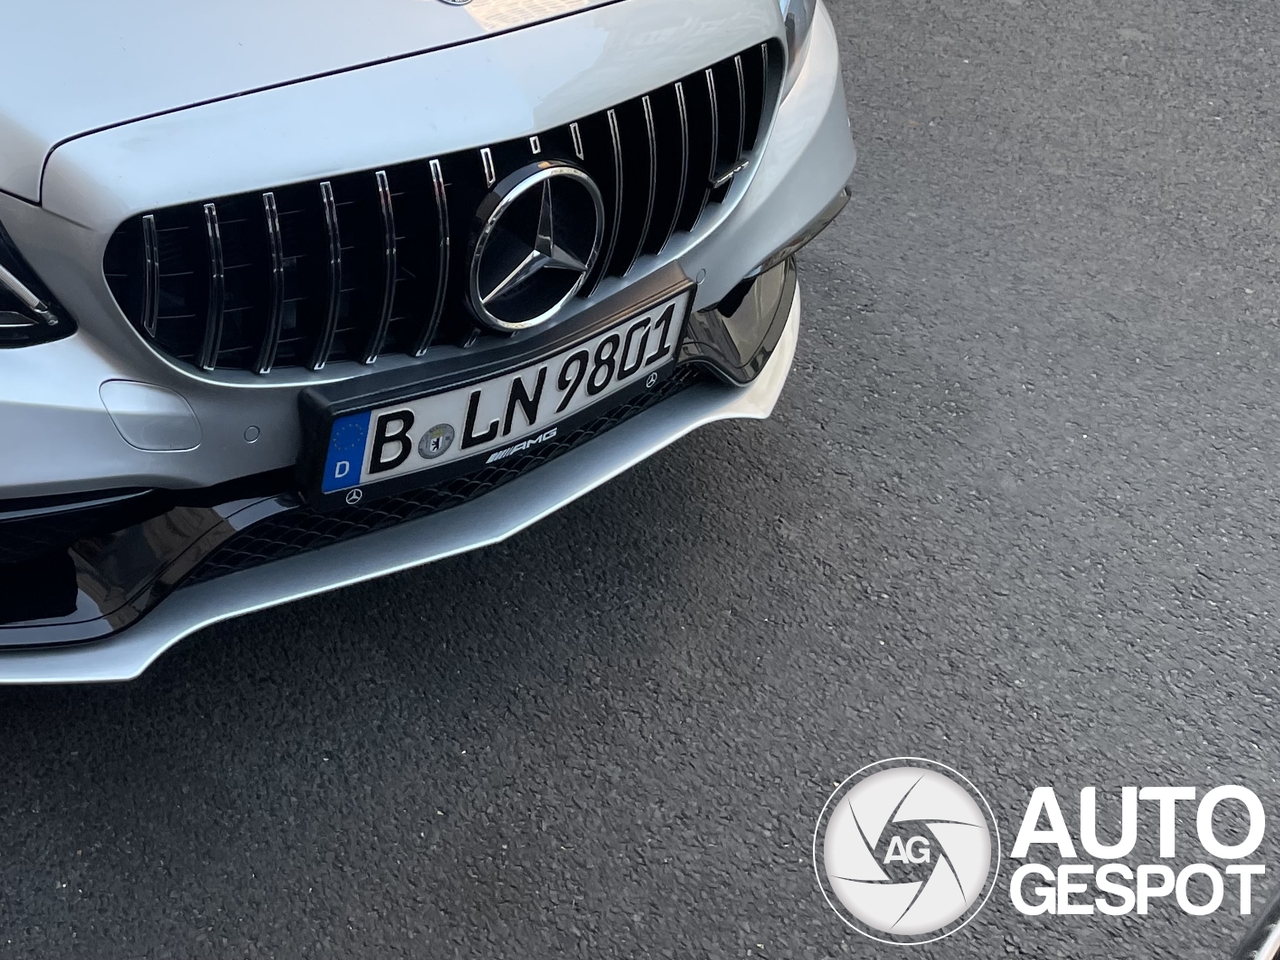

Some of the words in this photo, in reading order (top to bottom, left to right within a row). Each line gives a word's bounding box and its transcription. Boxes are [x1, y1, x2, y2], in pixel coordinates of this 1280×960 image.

[368, 408, 415, 474] B
[460, 366, 548, 450] LN
[555, 303, 676, 413] 9801
[334, 460, 350, 478] D
